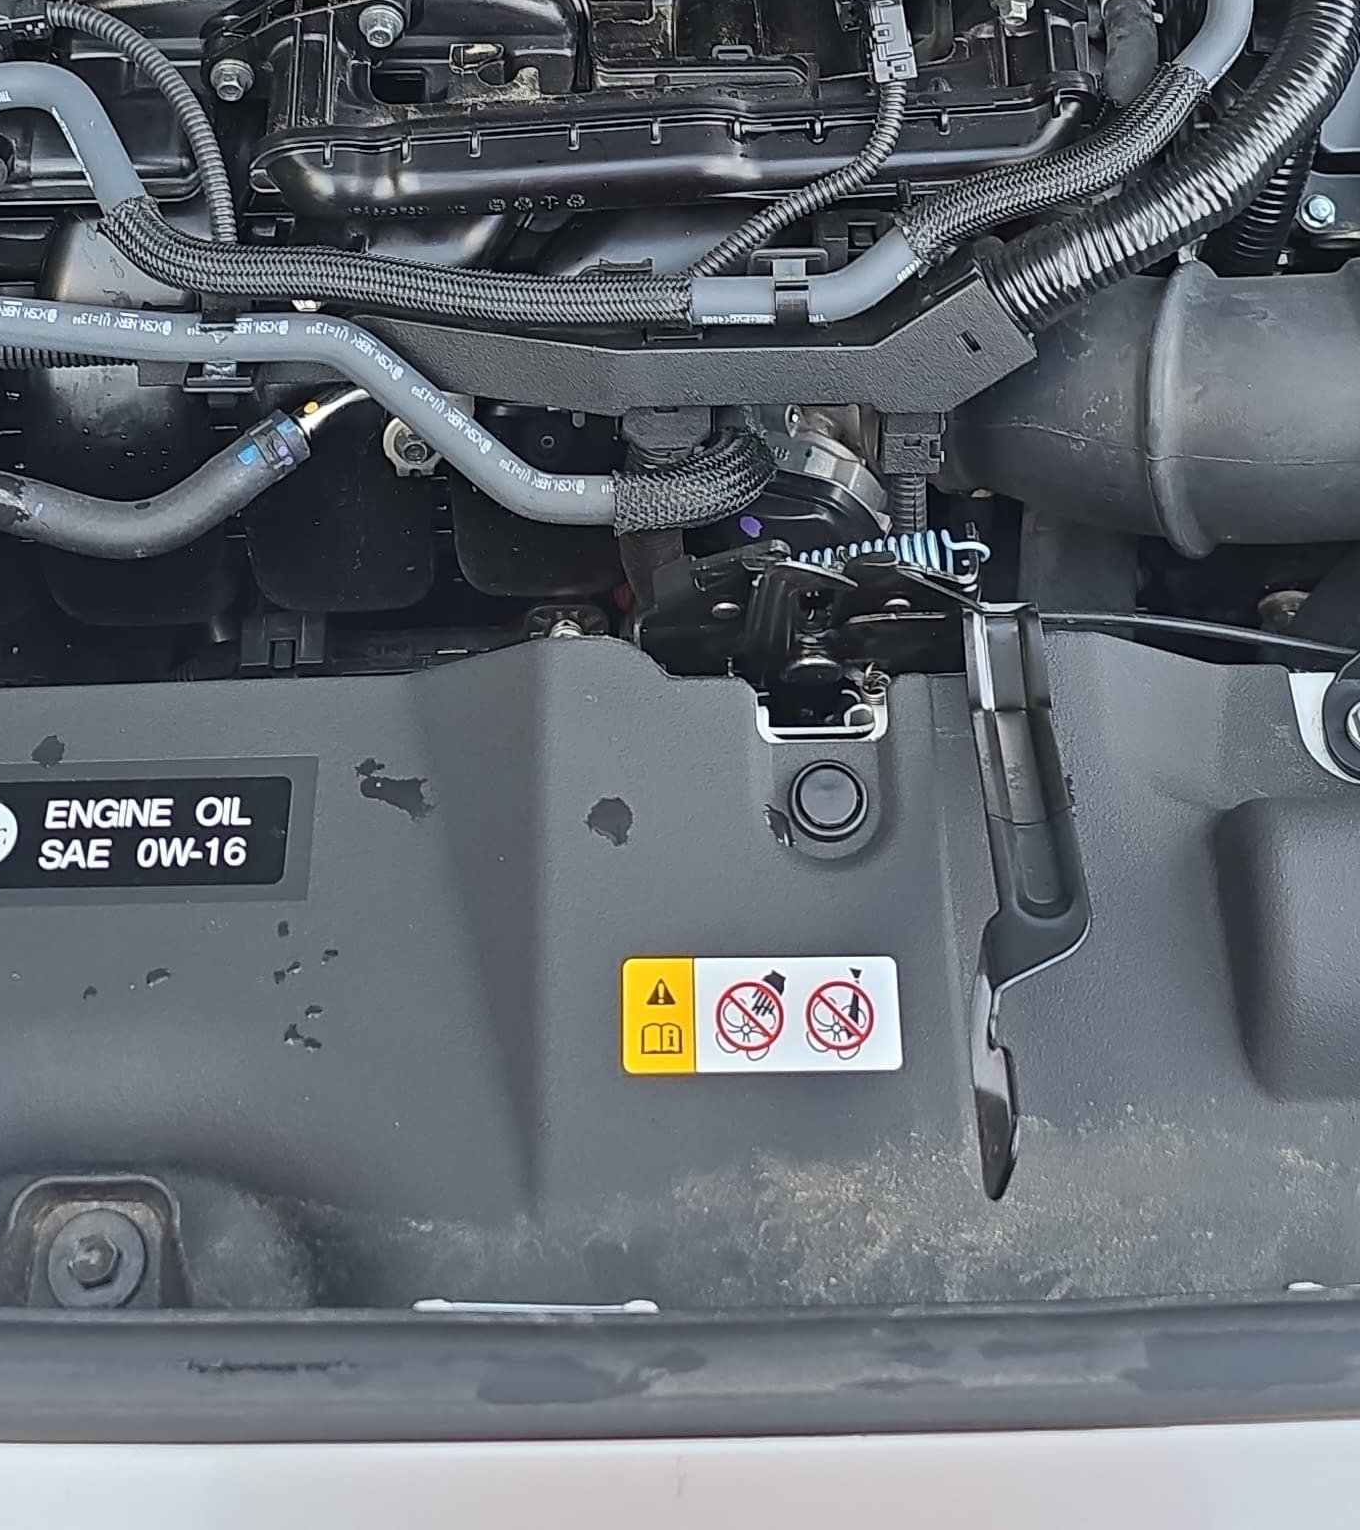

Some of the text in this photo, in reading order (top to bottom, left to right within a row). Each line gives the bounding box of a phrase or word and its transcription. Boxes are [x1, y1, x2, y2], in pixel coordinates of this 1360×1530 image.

[44, 796, 252, 830] ENGINE OIL
[38, 836, 248, 870] SAE 0W-16
